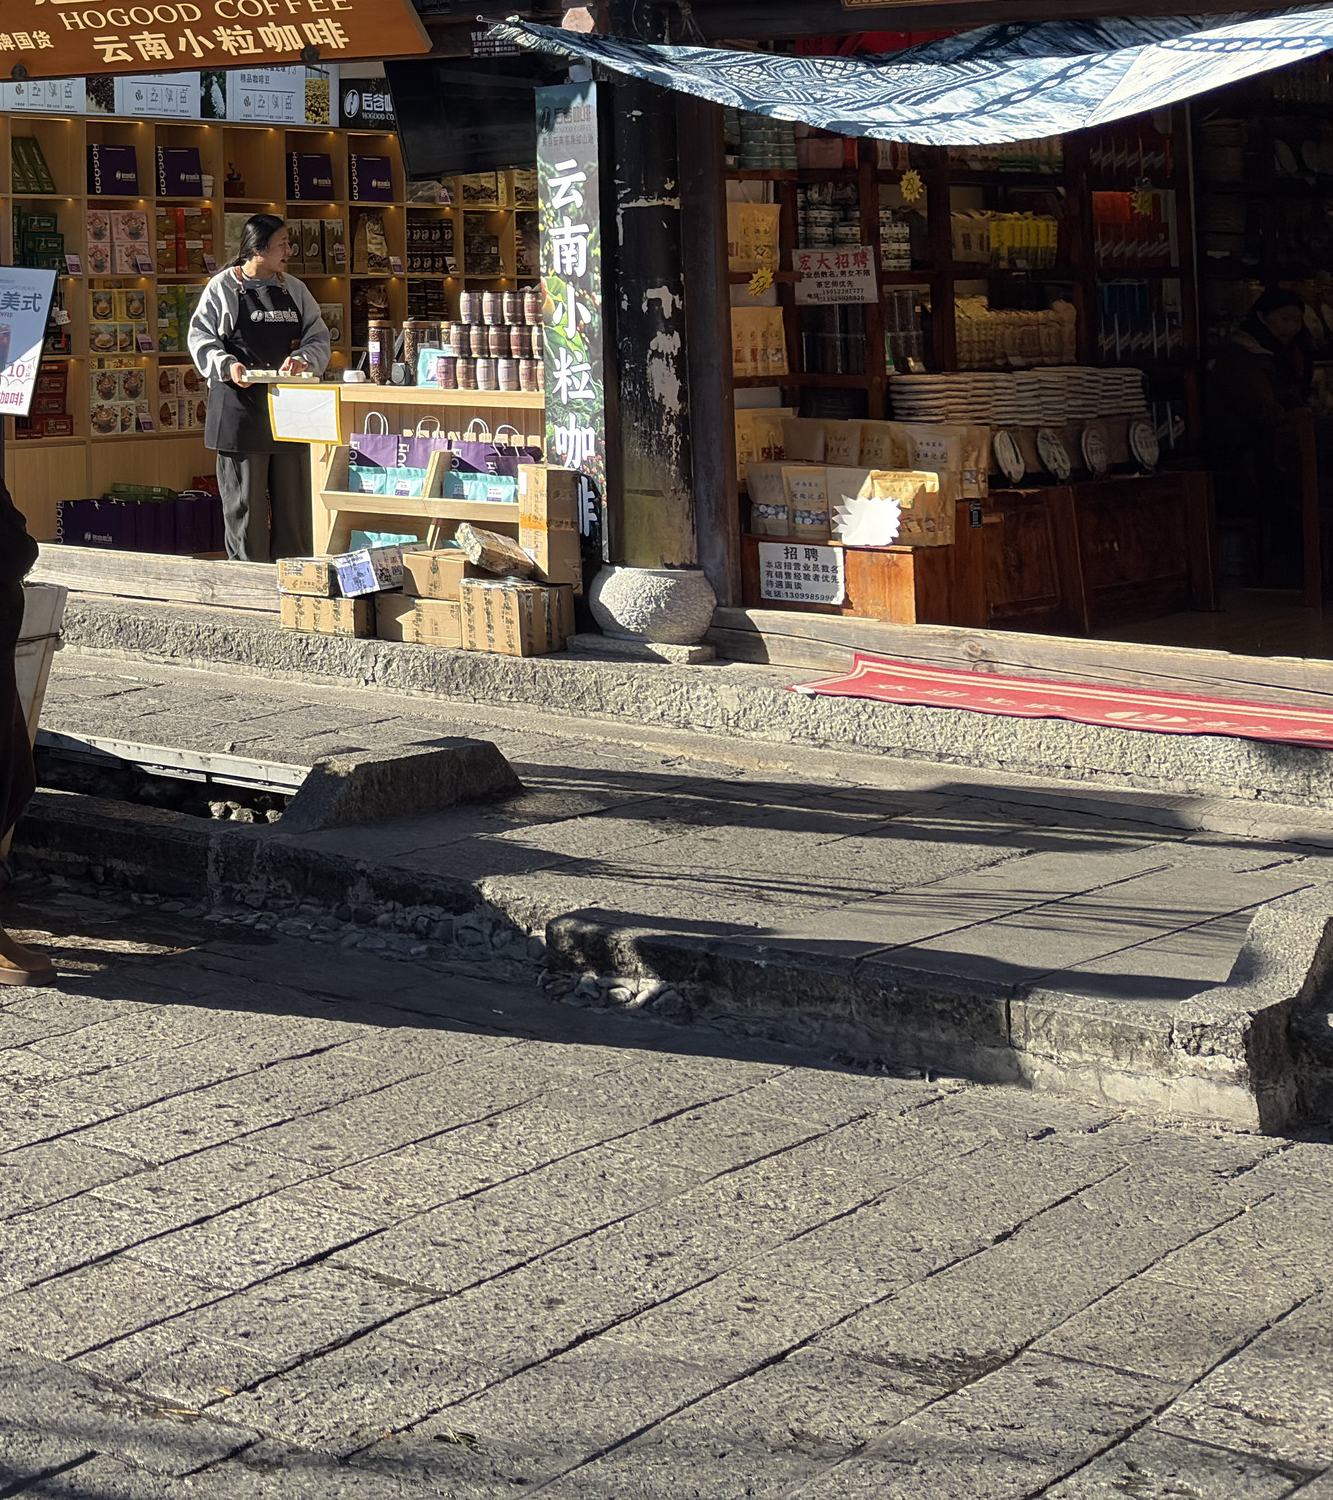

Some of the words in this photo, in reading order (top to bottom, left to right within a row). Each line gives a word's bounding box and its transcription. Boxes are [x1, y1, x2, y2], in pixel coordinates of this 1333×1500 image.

[57, 1, 203, 31] HOGOOD
[91, 17, 351, 64] 云南小粒咖啡
[798, 251, 870, 271] 宏大招聘
[7, 363, 25, 378] 10
[783, 545, 819, 562] 招聘
[765, 561, 839, 574] 本店招营业员数名
[765, 570, 840, 584] 有销售经验者优先
[765, 579, 803, 591] 待遇面谈
